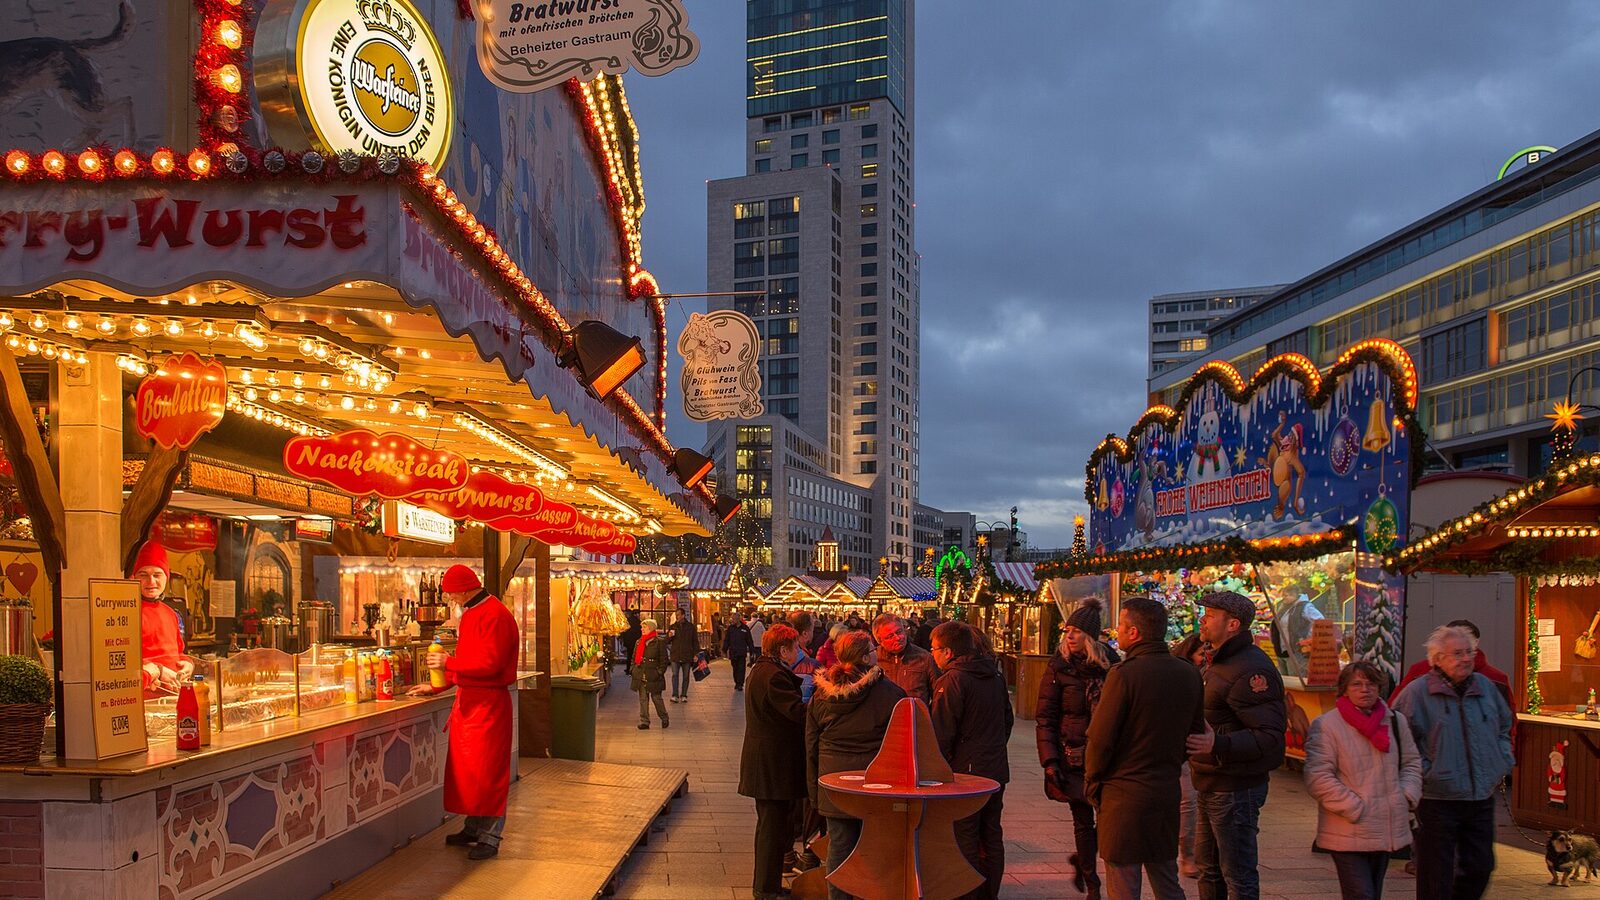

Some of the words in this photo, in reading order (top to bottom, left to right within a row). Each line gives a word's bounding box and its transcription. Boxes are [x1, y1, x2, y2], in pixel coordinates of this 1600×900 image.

[499, 27, 516, 39] mit
[520, 18, 583, 36] ofenfrischen
[588, 10, 634, 25] Brötchen
[329, 19, 358, 59] EINE
[510, 38, 568, 56] Beheizter
[571, 29, 632, 47] Gastraum
[328, 58, 364, 140] KÖNIGIN
[351, 58, 421, 116] Warsteiner
[416, 57, 436, 127] BIEREN
[361, 133, 408, 158] UNTER
[408, 125, 431, 156] DEN
[691, 377, 708, 387] Pils
[718, 375, 738, 384] Fass
[696, 363, 736, 375] Glühwein
[142, 378, 221, 427] Bouletten
[694, 386, 737, 397] Bratwurst
[296, 443, 460, 485] Nackensteak
[1156, 484, 1187, 517] FROHE
[1188, 467, 1271, 514] WEIHNACHTEN
[411, 511, 447, 535] WARSTEINER
[574, 520, 611, 540] Kakao
[95, 596, 137, 610] Currywurst
[105, 616, 115, 627] ab
[117, 615, 129, 627] 18!
[104, 638, 115, 647] Mit
[109, 653, 126, 667] 3,50€
[95, 678, 140, 692] Käsekrainer
[100, 700, 109, 708] m.
[110, 696, 137, 708] Brötchen
[112, 717, 129, 732] 3,00€
